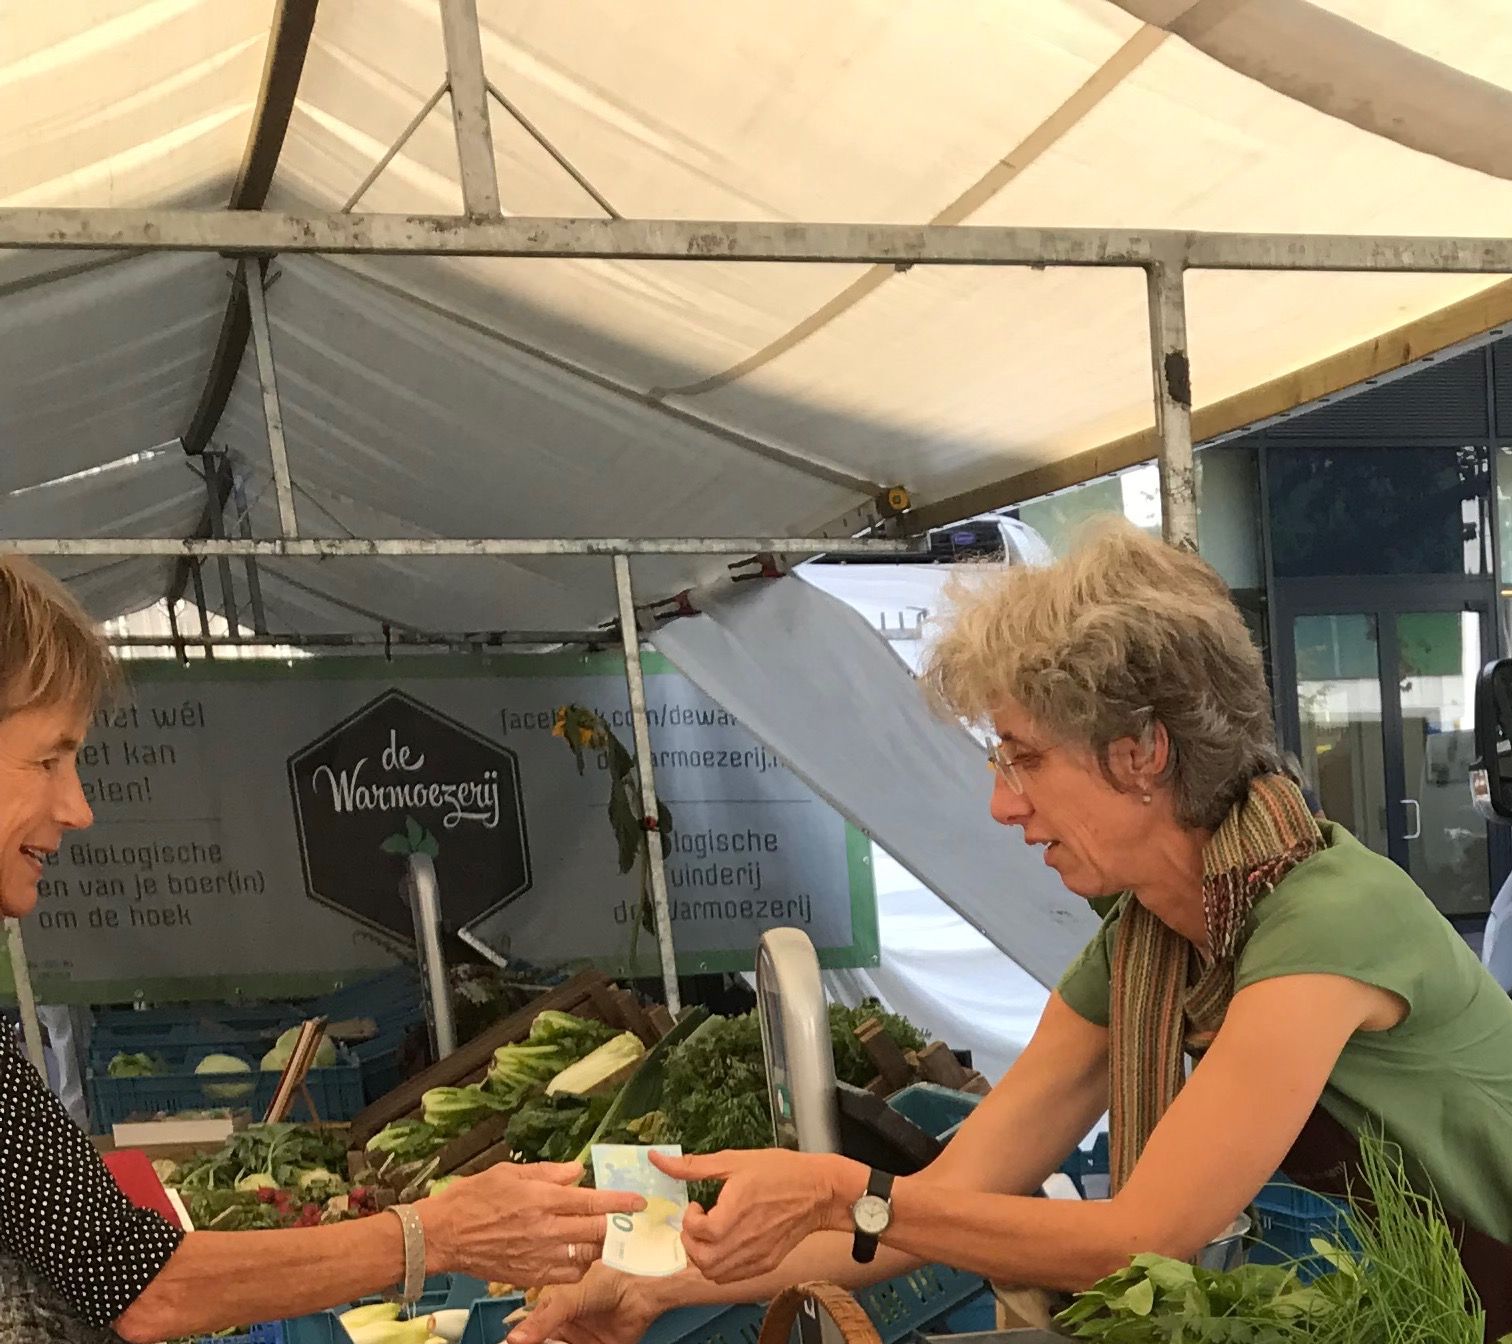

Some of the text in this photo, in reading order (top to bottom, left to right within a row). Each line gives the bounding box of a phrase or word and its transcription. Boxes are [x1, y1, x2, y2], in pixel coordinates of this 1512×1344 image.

[124, 741, 177, 766] kan
[381, 729, 424, 771] de
[312, 757, 499, 828] Warmoezerij
[79, 878, 125, 897] van
[134, 873, 158, 902] je
[167, 869, 265, 897] boer(in)
[38, 904, 192, 929] om de hoek
